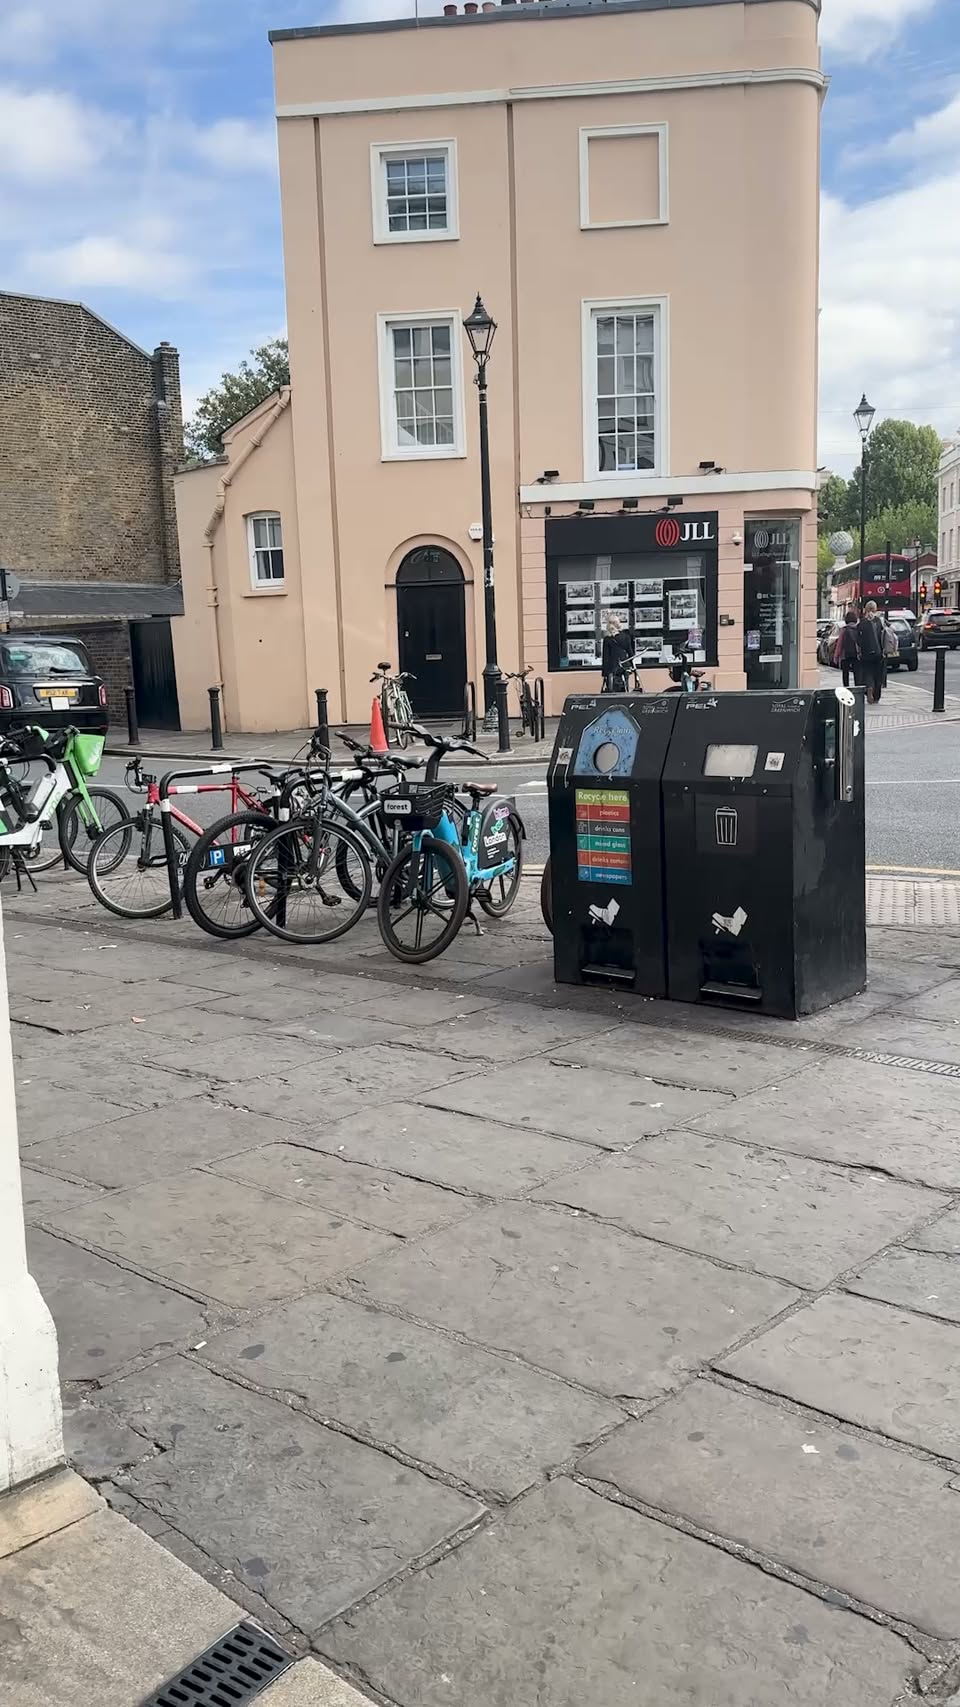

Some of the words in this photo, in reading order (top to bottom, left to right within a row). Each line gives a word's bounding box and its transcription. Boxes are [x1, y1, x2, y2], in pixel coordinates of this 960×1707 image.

[680, 521, 715, 541] JLL
[770, 533, 788, 545] JLL
[578, 791, 606, 802] Recycle
[608, 793, 628, 802] here
[471, 816, 481, 853] forest
[594, 825, 611, 833] drinks
[214, 850, 222, 864] P
